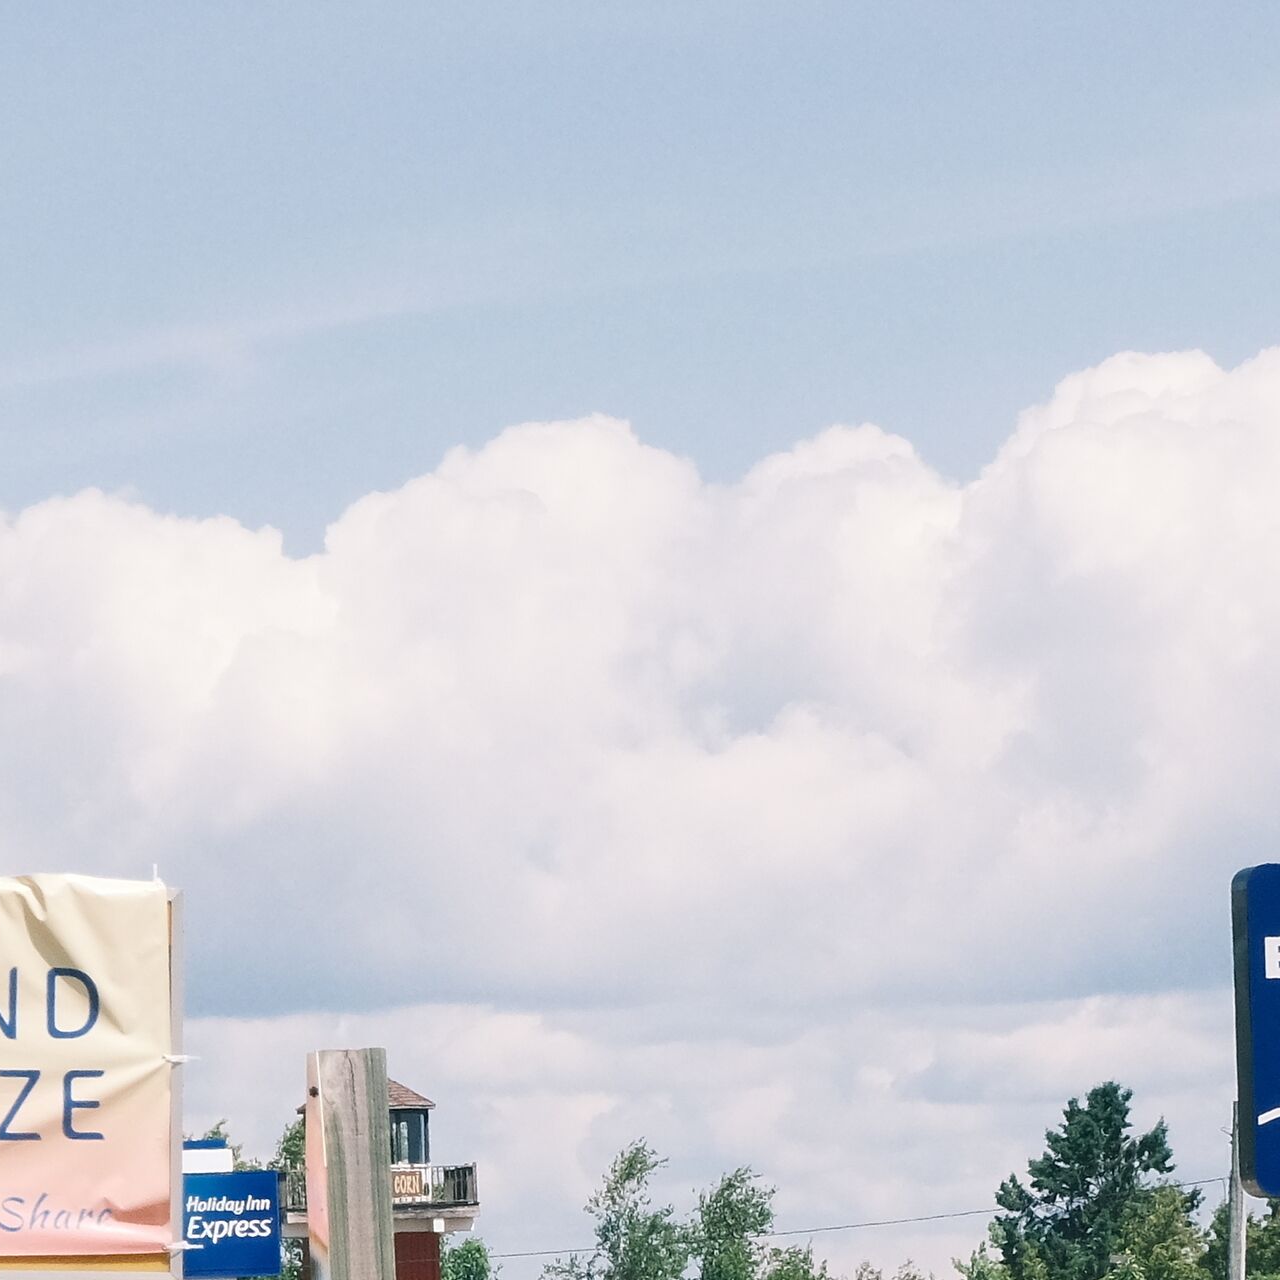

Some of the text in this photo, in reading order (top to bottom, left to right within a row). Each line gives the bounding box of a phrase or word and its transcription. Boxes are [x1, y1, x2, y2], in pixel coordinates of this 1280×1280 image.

[394, 1175, 421, 1194] CORN
[186, 1195, 270, 1214] Holiday Inn
[187, 1216, 272, 1244] Express
